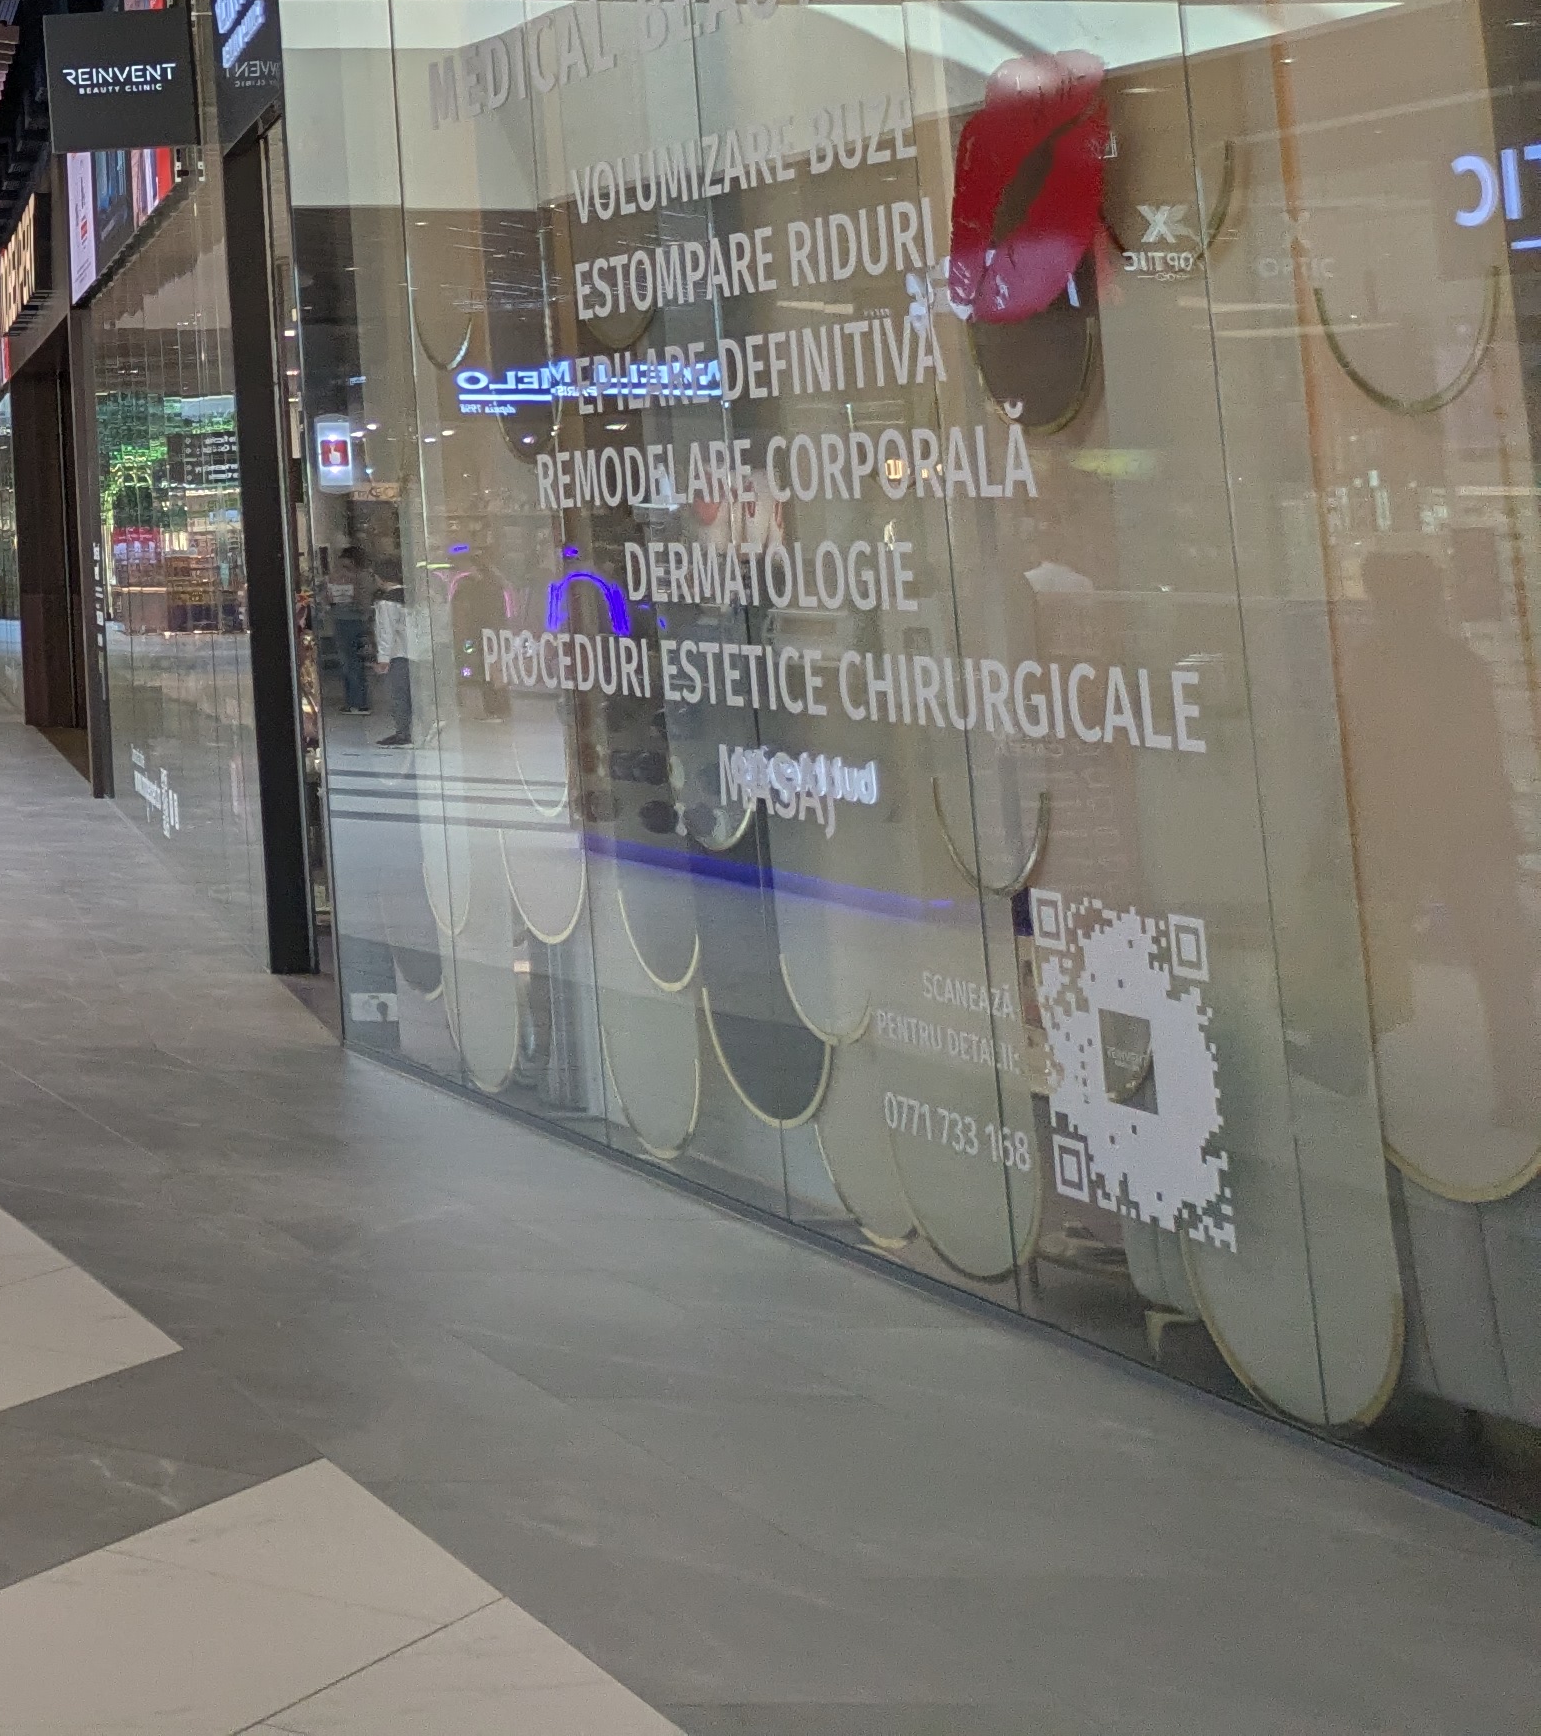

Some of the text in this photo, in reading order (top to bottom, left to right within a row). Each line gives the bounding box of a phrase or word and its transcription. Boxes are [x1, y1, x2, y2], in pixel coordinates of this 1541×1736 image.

[62, 63, 176, 85] REINVENT
[79, 83, 162, 94] BEAUTY CLINIC
[571, 95, 917, 224] VOLUMIZARE BUZE
[575, 197, 935, 320] ESTOMPARE RIDURI
[537, 400, 1039, 510] REMODELARE CORPORALĂ
[625, 541, 918, 611] DERMATOLOGIE
[481, 627, 1207, 753] PROCEDURI ESTETICE CHIRURGICALE
[884, 1091, 1031, 1172] 0771 733 168
